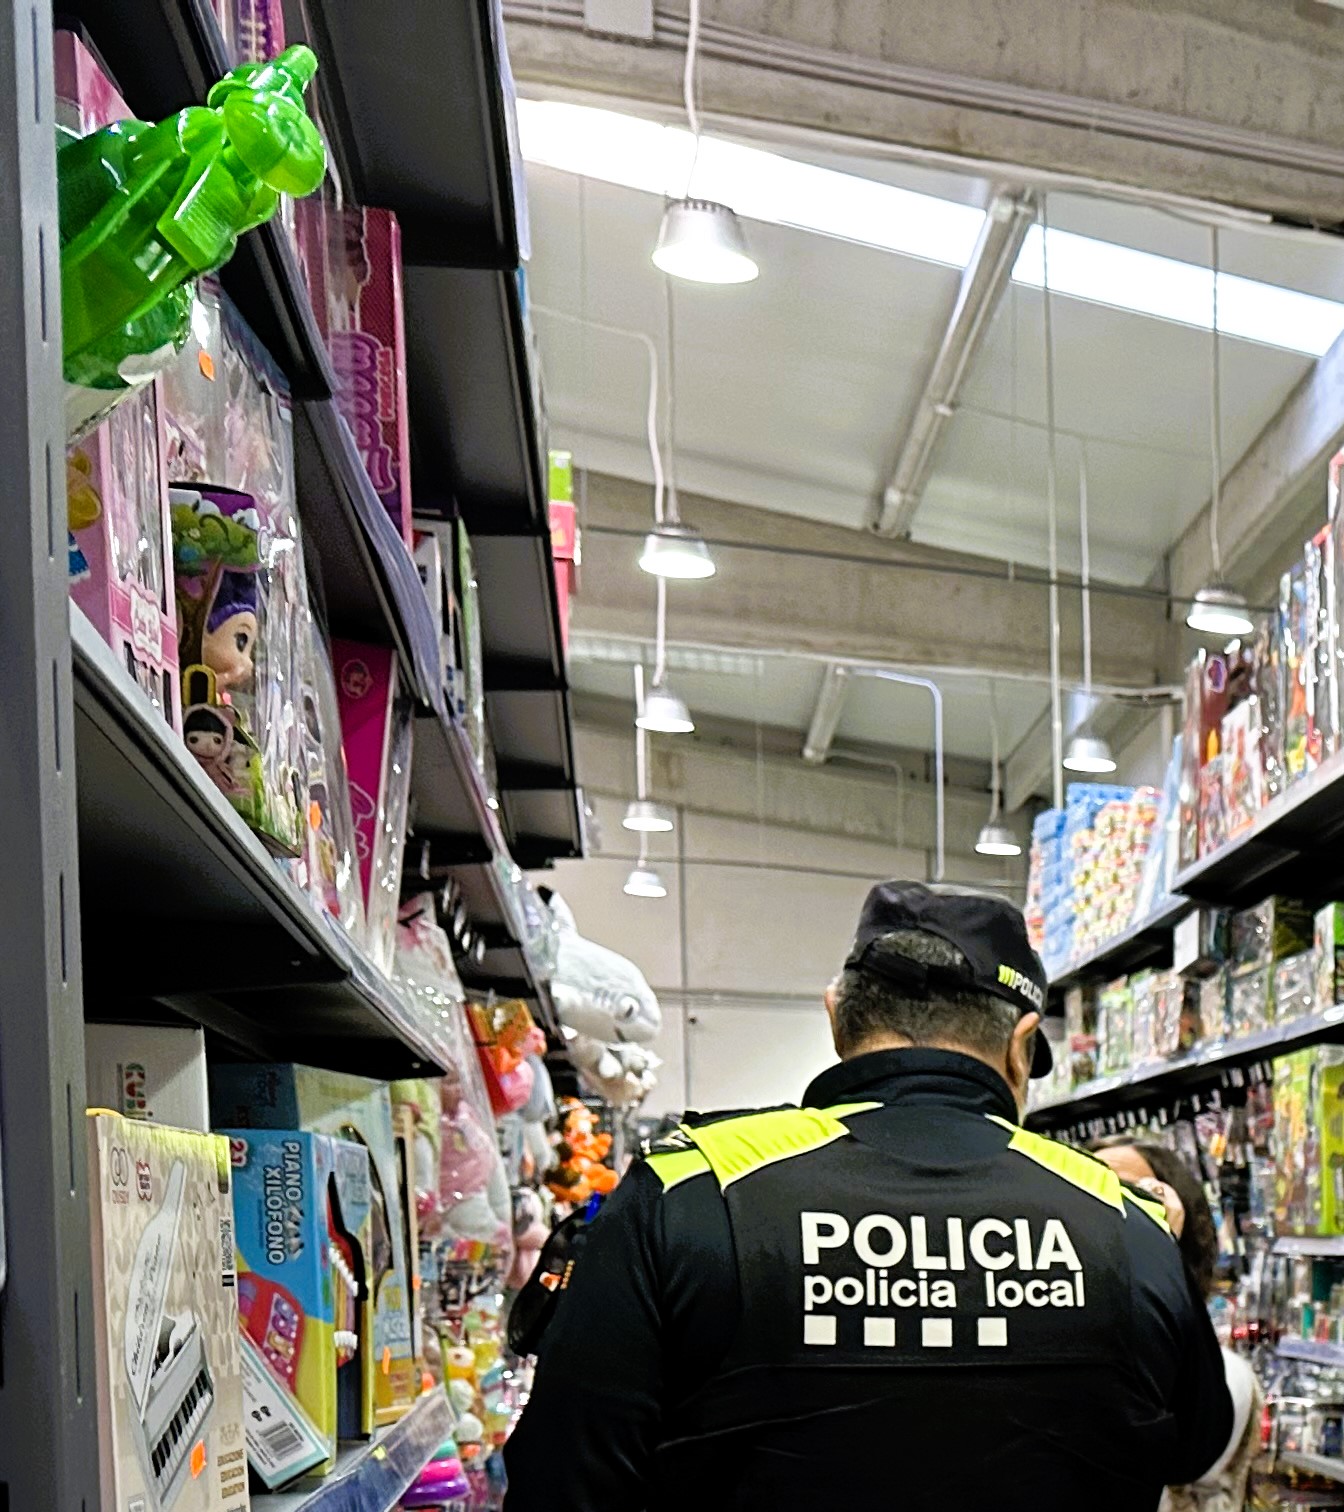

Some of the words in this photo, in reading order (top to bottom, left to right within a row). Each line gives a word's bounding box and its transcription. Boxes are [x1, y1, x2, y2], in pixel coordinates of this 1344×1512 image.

[285, 1142, 302, 1201] PIANO
[266, 1166, 285, 1265] XILÓFONO
[800, 1211, 1084, 1272] POLICIA
[803, 1269, 957, 1310] policia
[985, 1270, 1085, 1308] local
